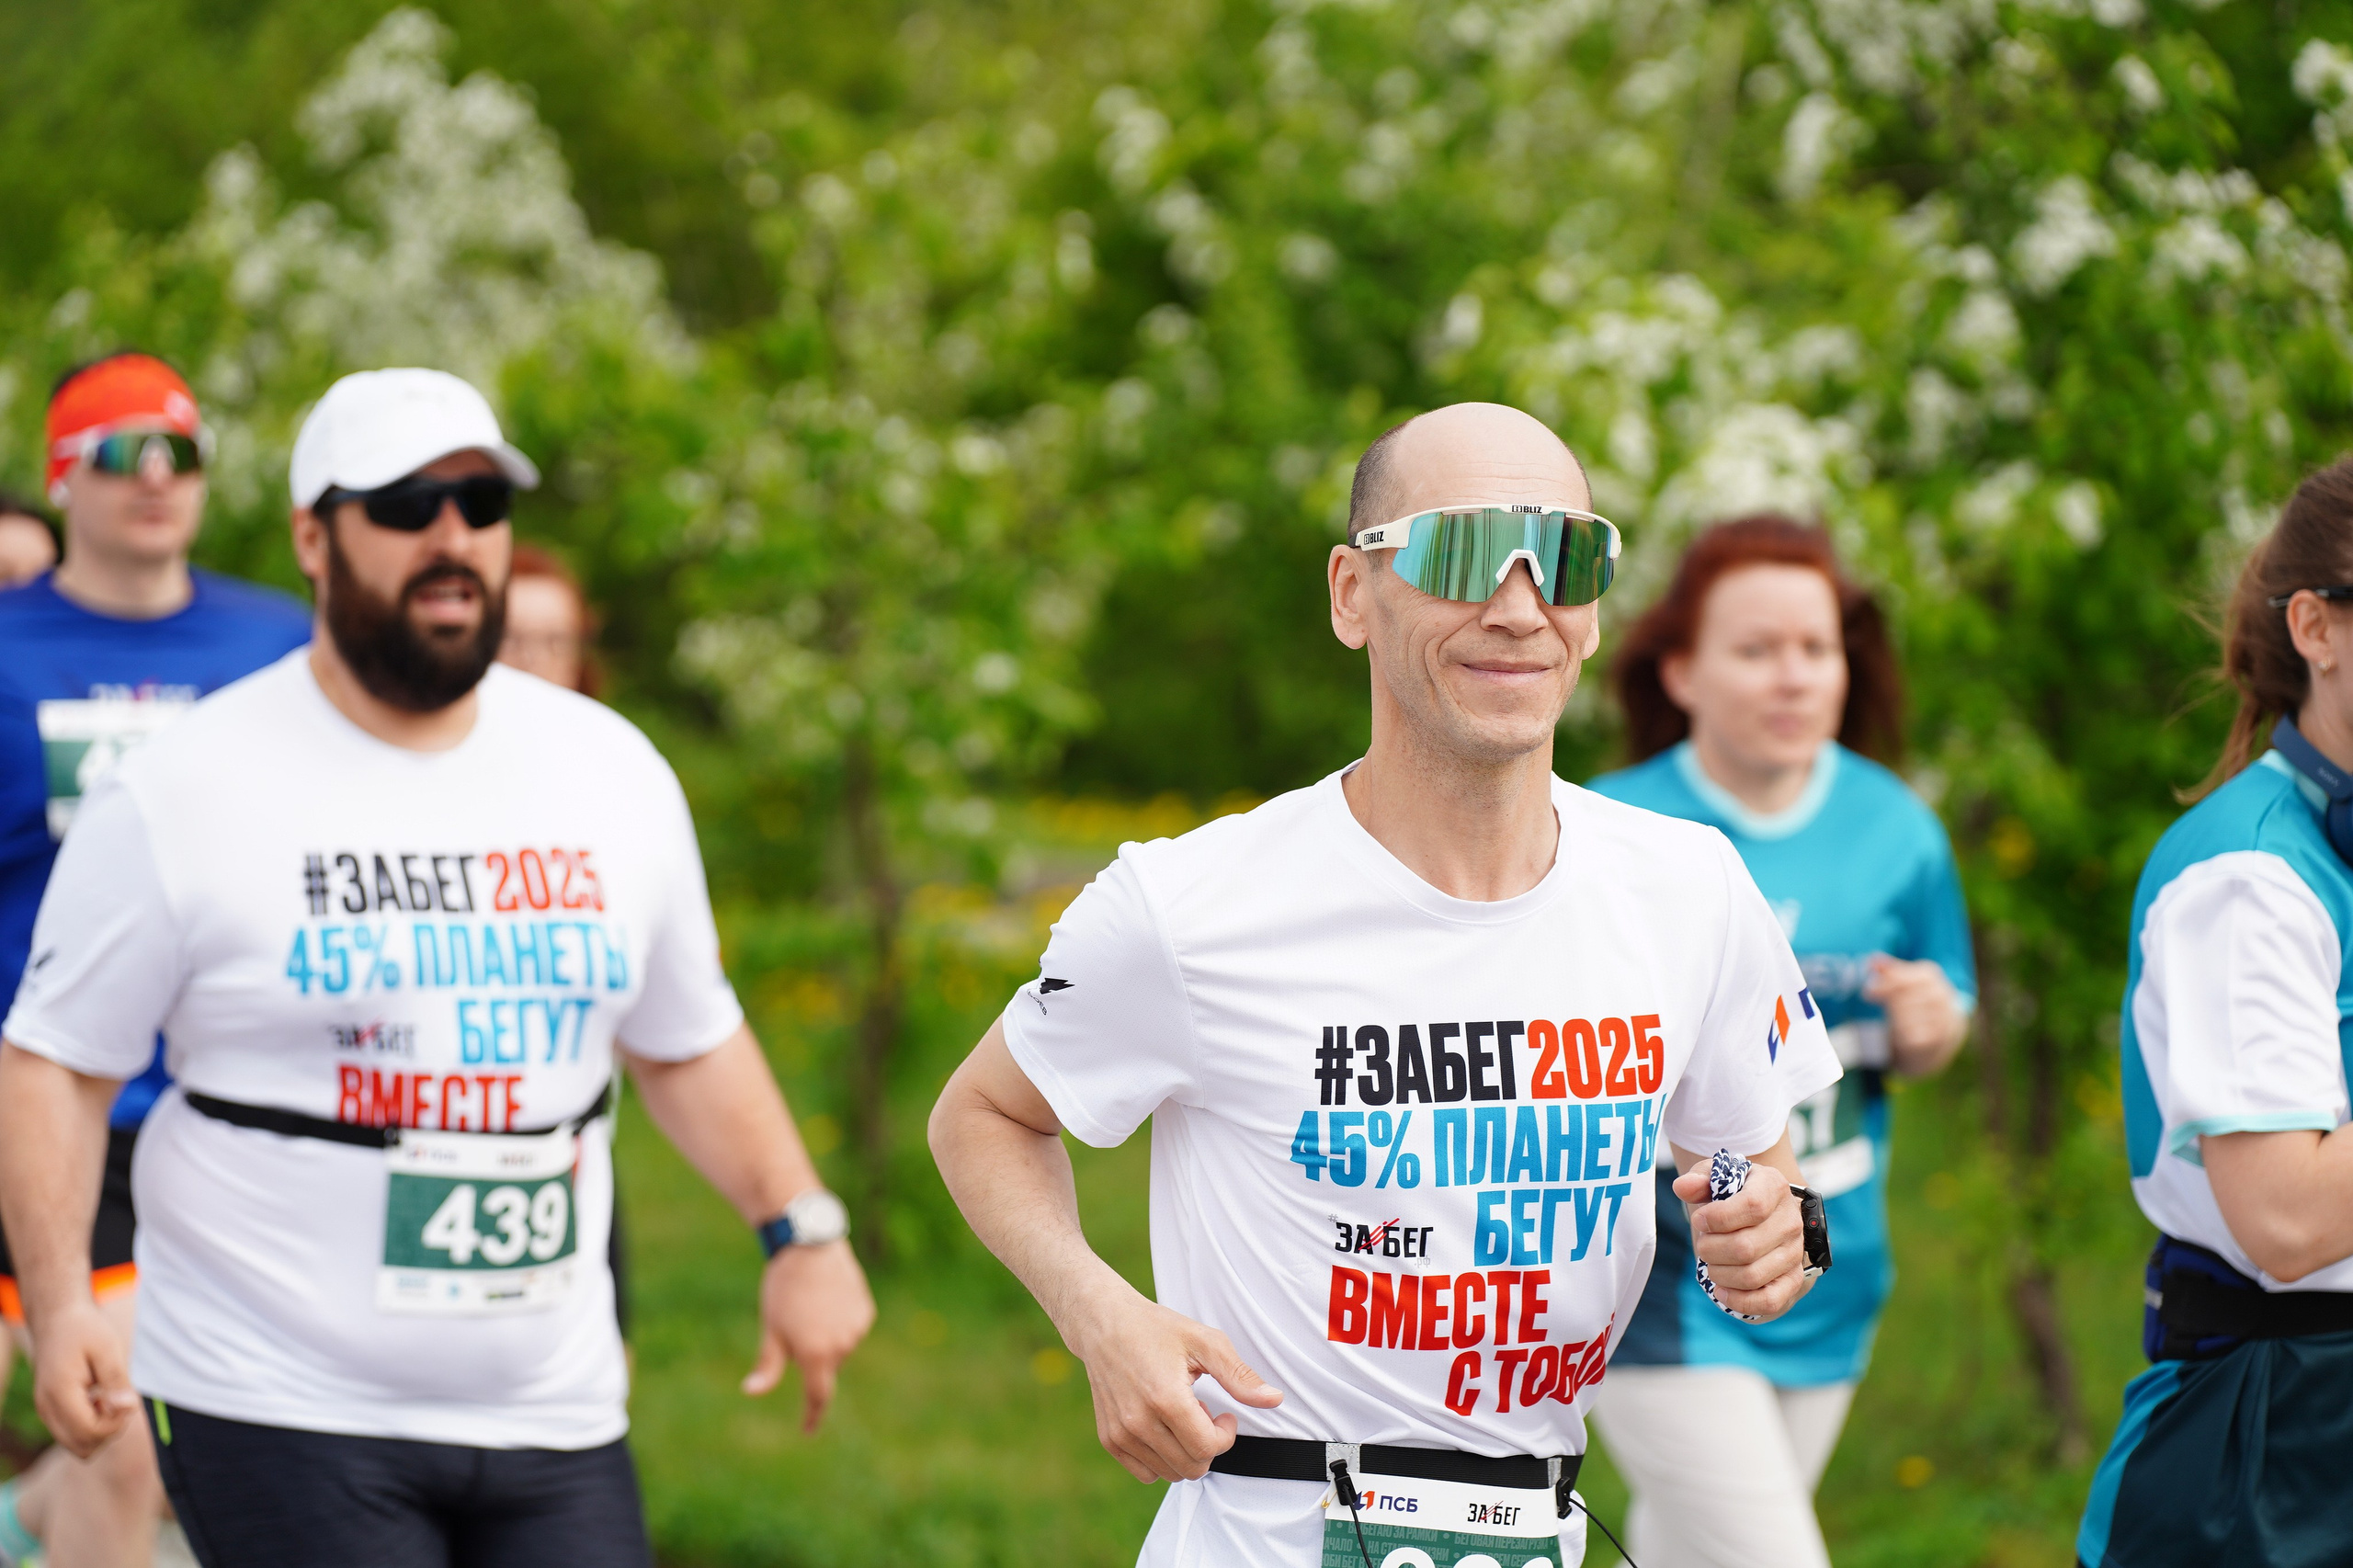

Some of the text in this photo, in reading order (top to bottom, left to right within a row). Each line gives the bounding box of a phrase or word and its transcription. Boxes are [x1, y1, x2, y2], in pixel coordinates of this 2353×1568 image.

[1370, 530, 1384, 544] BLIZ
[1523, 505, 1543, 514] BLIZ
[304, 848, 606, 915] #ЗАБЕГ2025
[287, 925, 402, 994] 45%
[457, 997, 596, 1065] БЕГУТ
[1314, 1013, 1665, 1106] #ЗАБЕГ2025
[336, 1063, 524, 1132] ВМЕСТЕ
[1290, 1110, 1421, 1189] 45%
[422, 1182, 569, 1266] 439
[1474, 1183, 1632, 1267] БЕГУТ
[1327, 1265, 1552, 1351] ВМЕСТЕ
[1445, 1350, 1482, 1416] С
[1380, 1494, 1418, 1513] ПСБ
